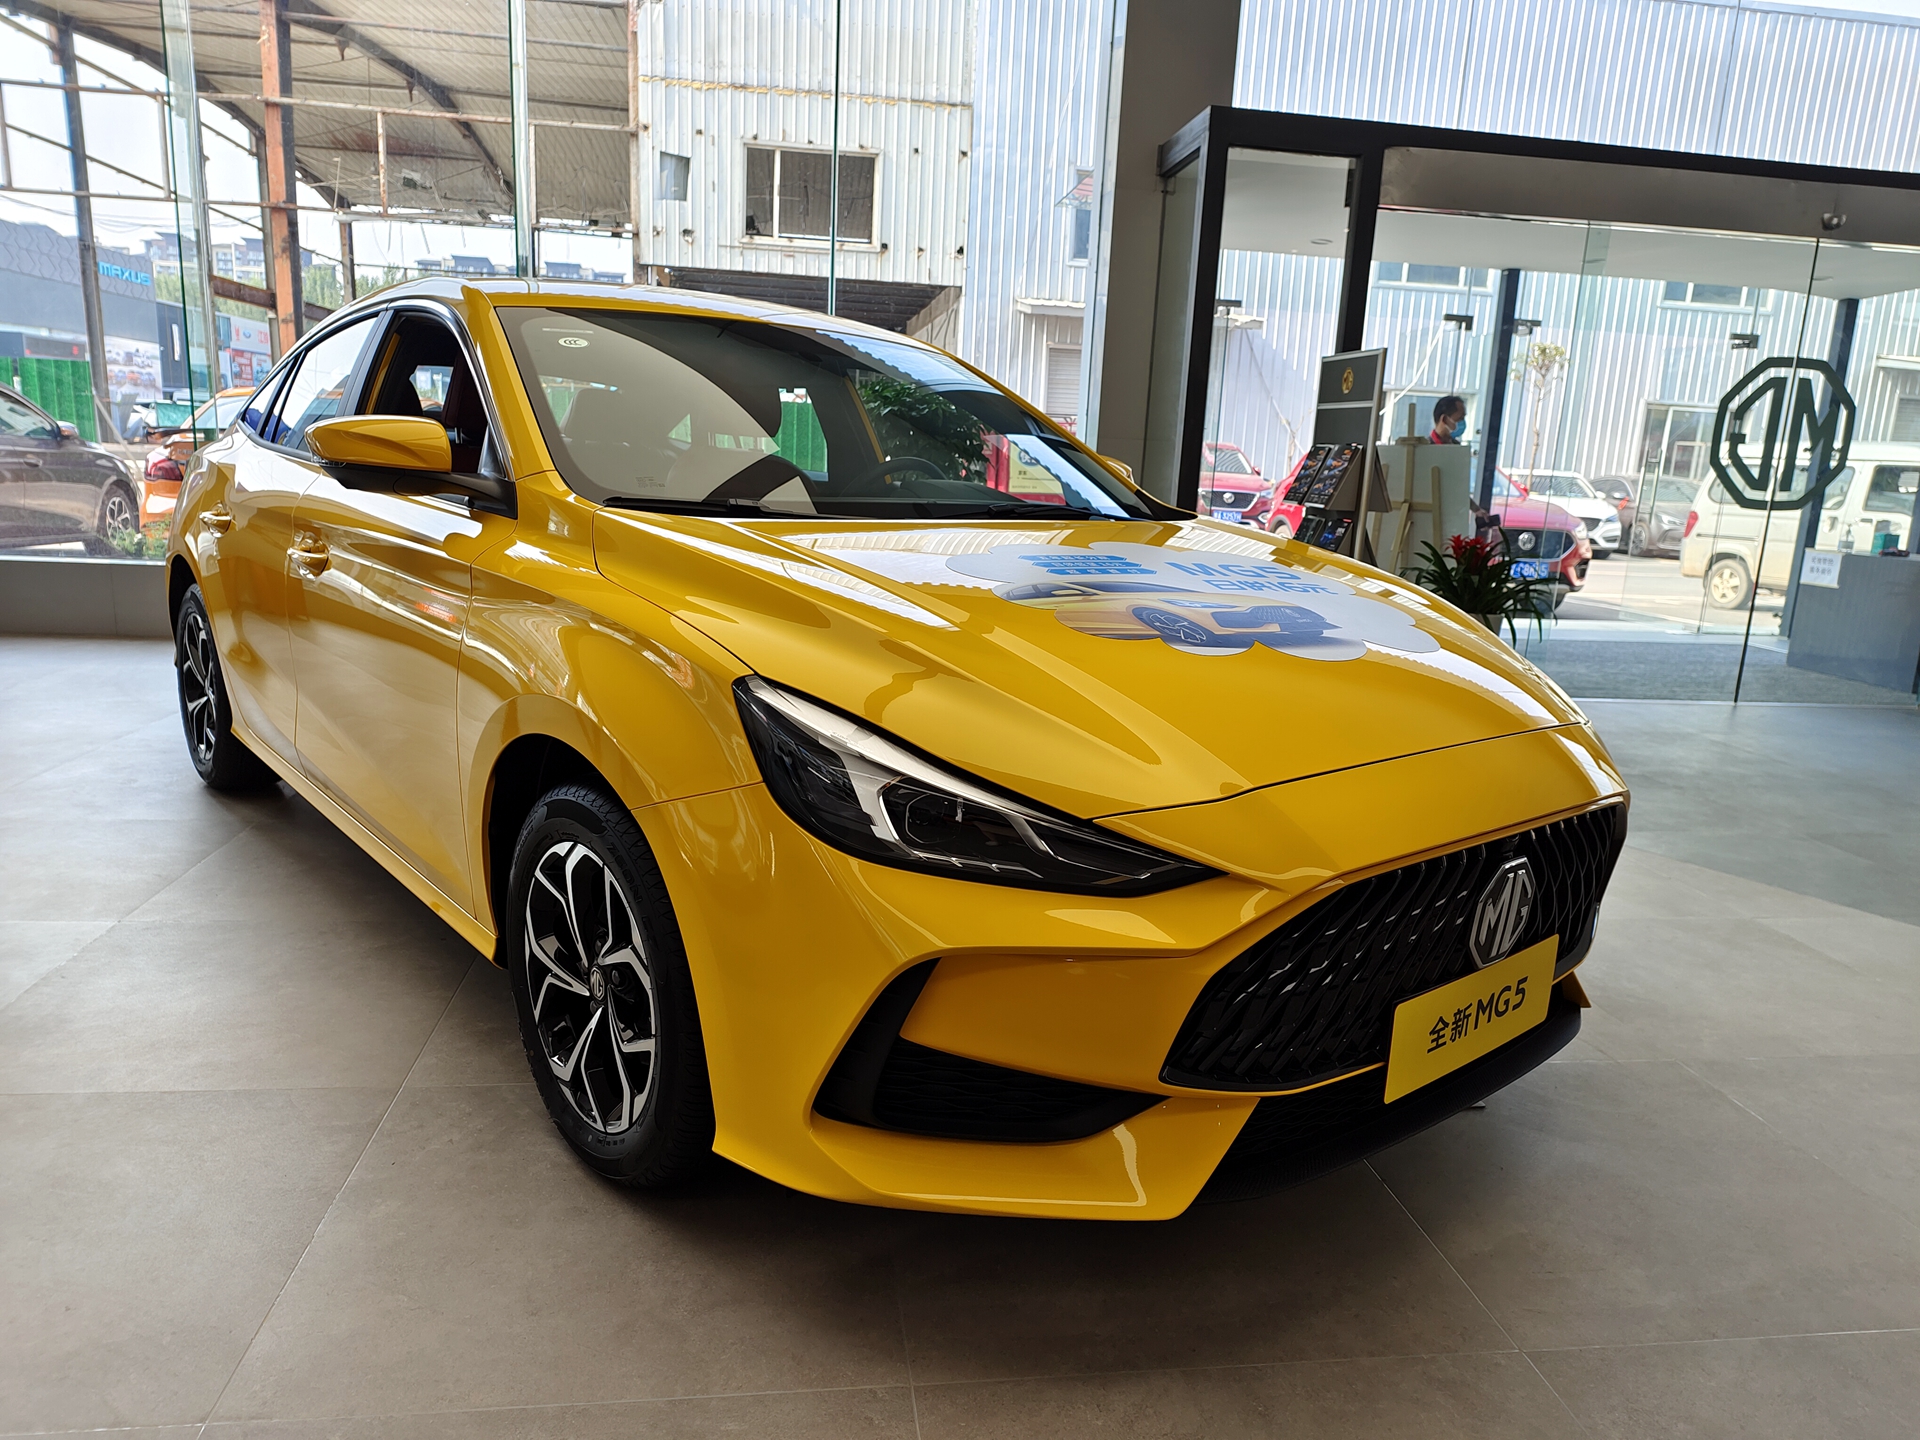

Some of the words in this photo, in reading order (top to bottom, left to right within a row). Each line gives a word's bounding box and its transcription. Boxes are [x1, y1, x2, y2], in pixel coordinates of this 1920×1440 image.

[98, 261, 151, 286] MAXUS
[1164, 561, 1302, 580] MG5
[1477, 867, 1533, 960] MG
[1426, 975, 1529, 1055] 全新MG5
